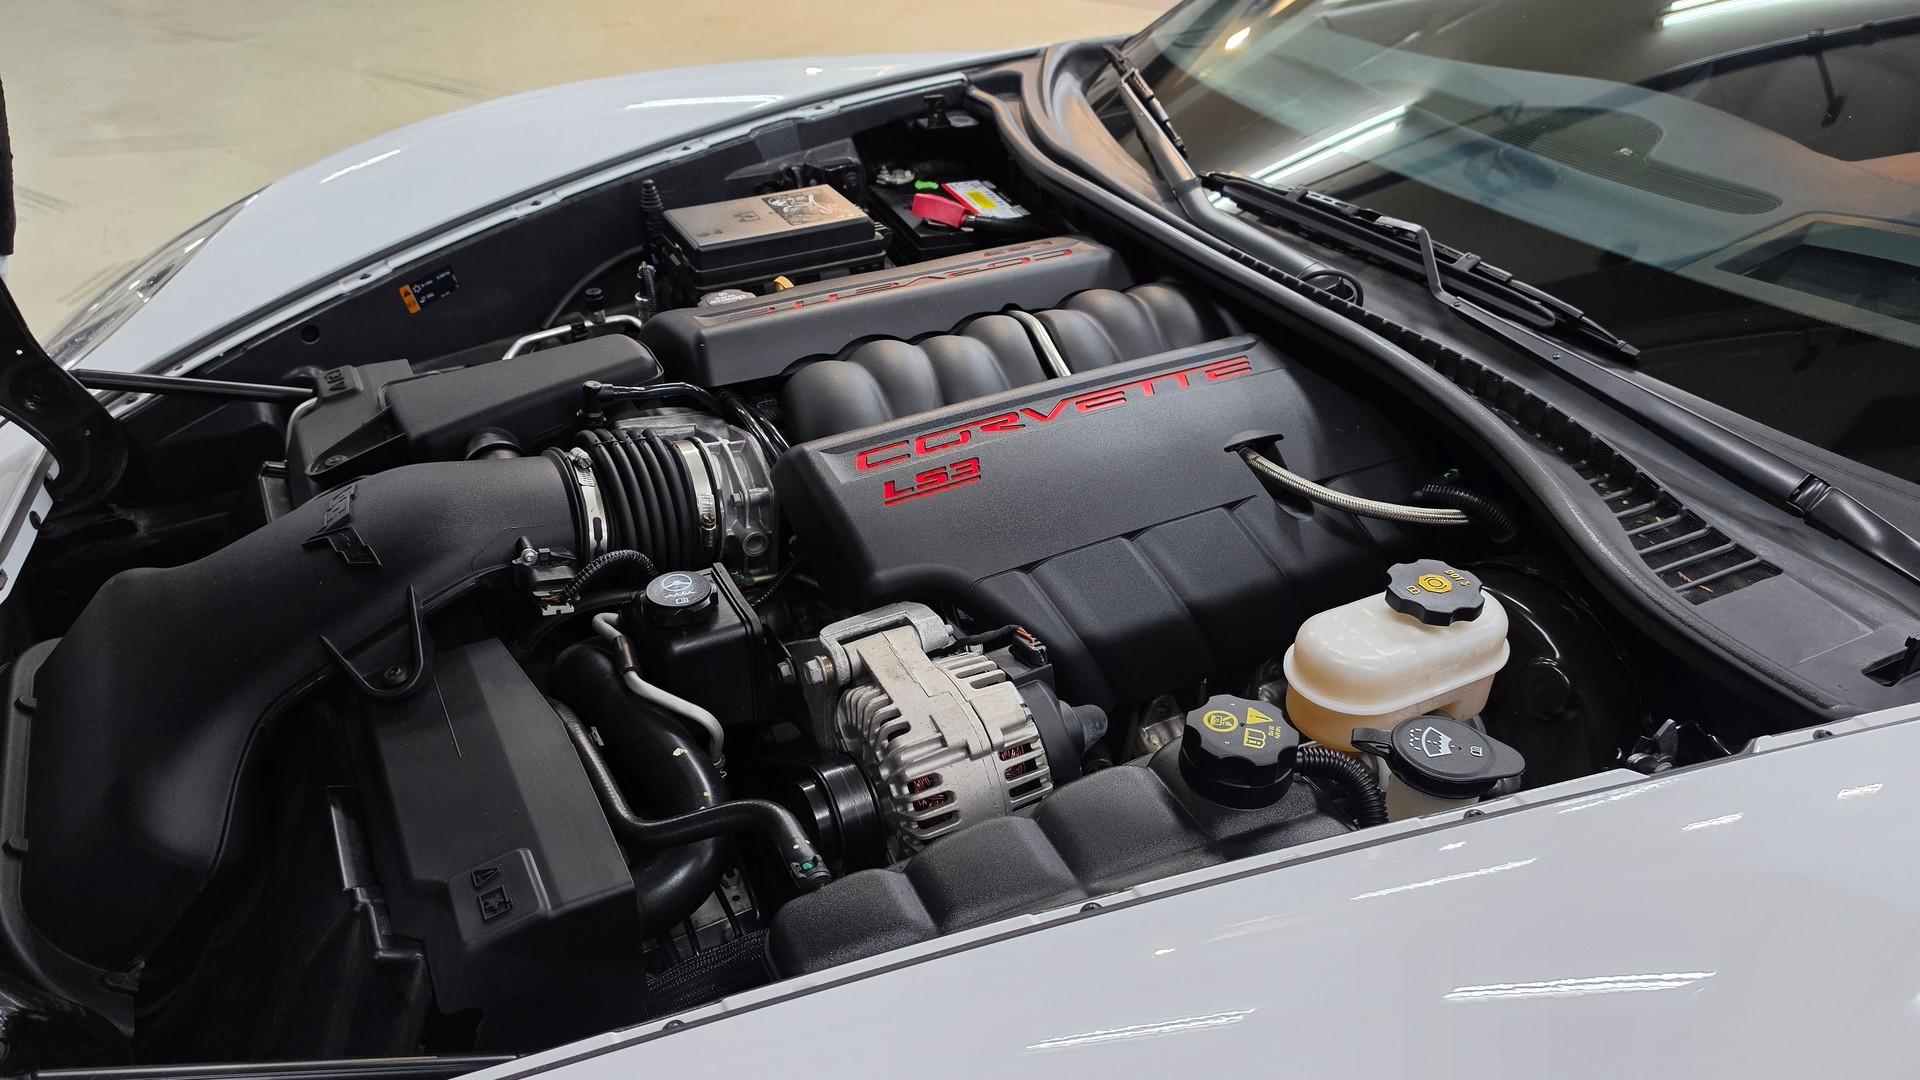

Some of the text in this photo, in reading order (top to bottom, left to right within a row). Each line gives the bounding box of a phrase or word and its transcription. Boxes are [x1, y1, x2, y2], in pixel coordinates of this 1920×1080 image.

[855, 354, 1253, 472] CORVETTE
[883, 456, 983, 503] LS3
[1444, 570, 1465, 582] DOT
